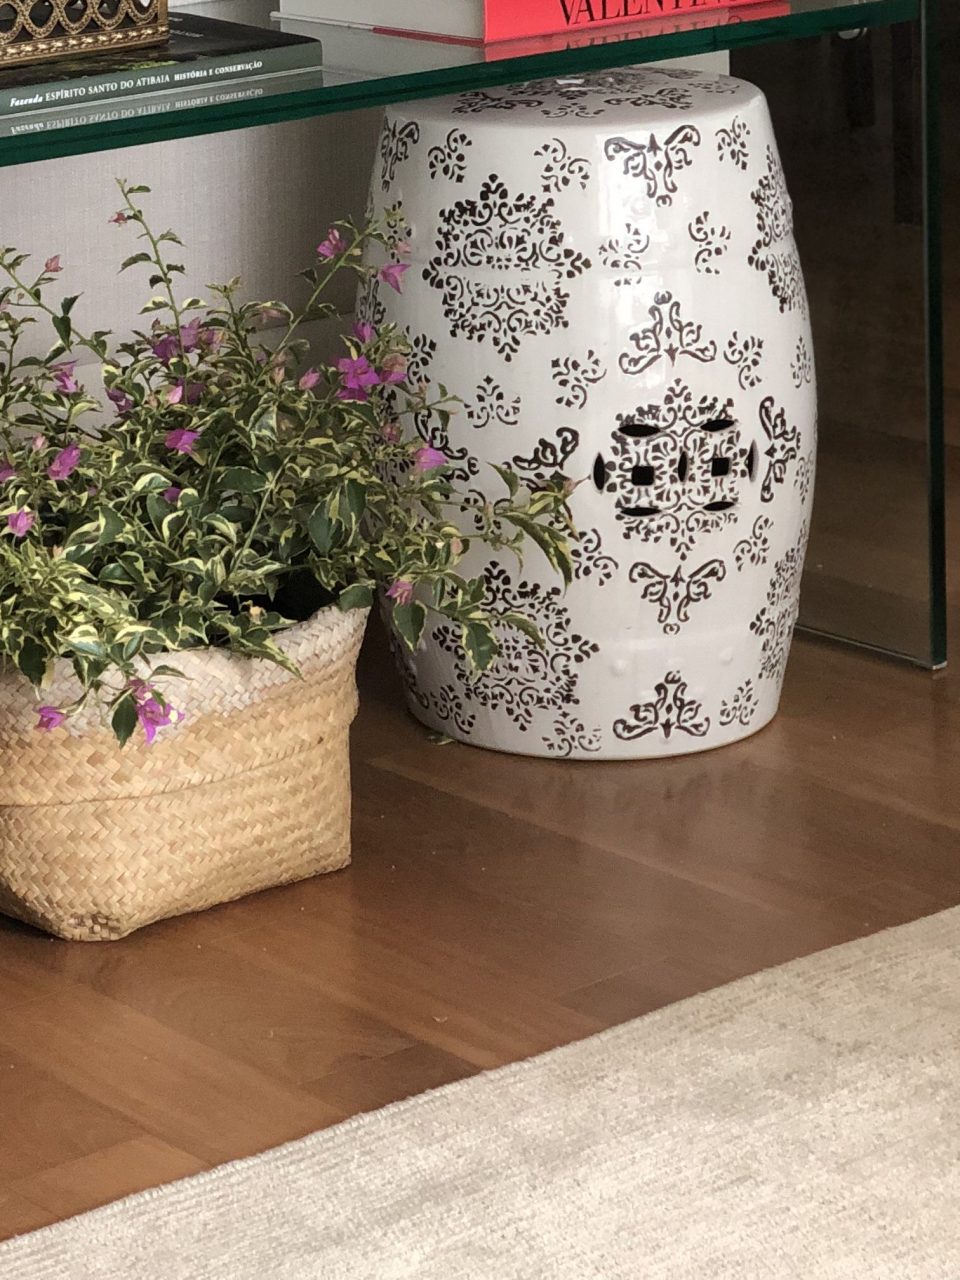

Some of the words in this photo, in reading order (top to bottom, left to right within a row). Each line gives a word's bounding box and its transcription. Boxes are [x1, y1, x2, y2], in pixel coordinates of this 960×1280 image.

[45, 86, 86, 102] ESPÍRITO
[88, 82, 118, 95] SANTO
[120, 79, 134, 89] DO
[136, 74, 170, 87] ATIBAIA
[174, 69, 207, 81] HISTÓRIA
[214, 61, 263, 75] CONSERVAÇÃO
